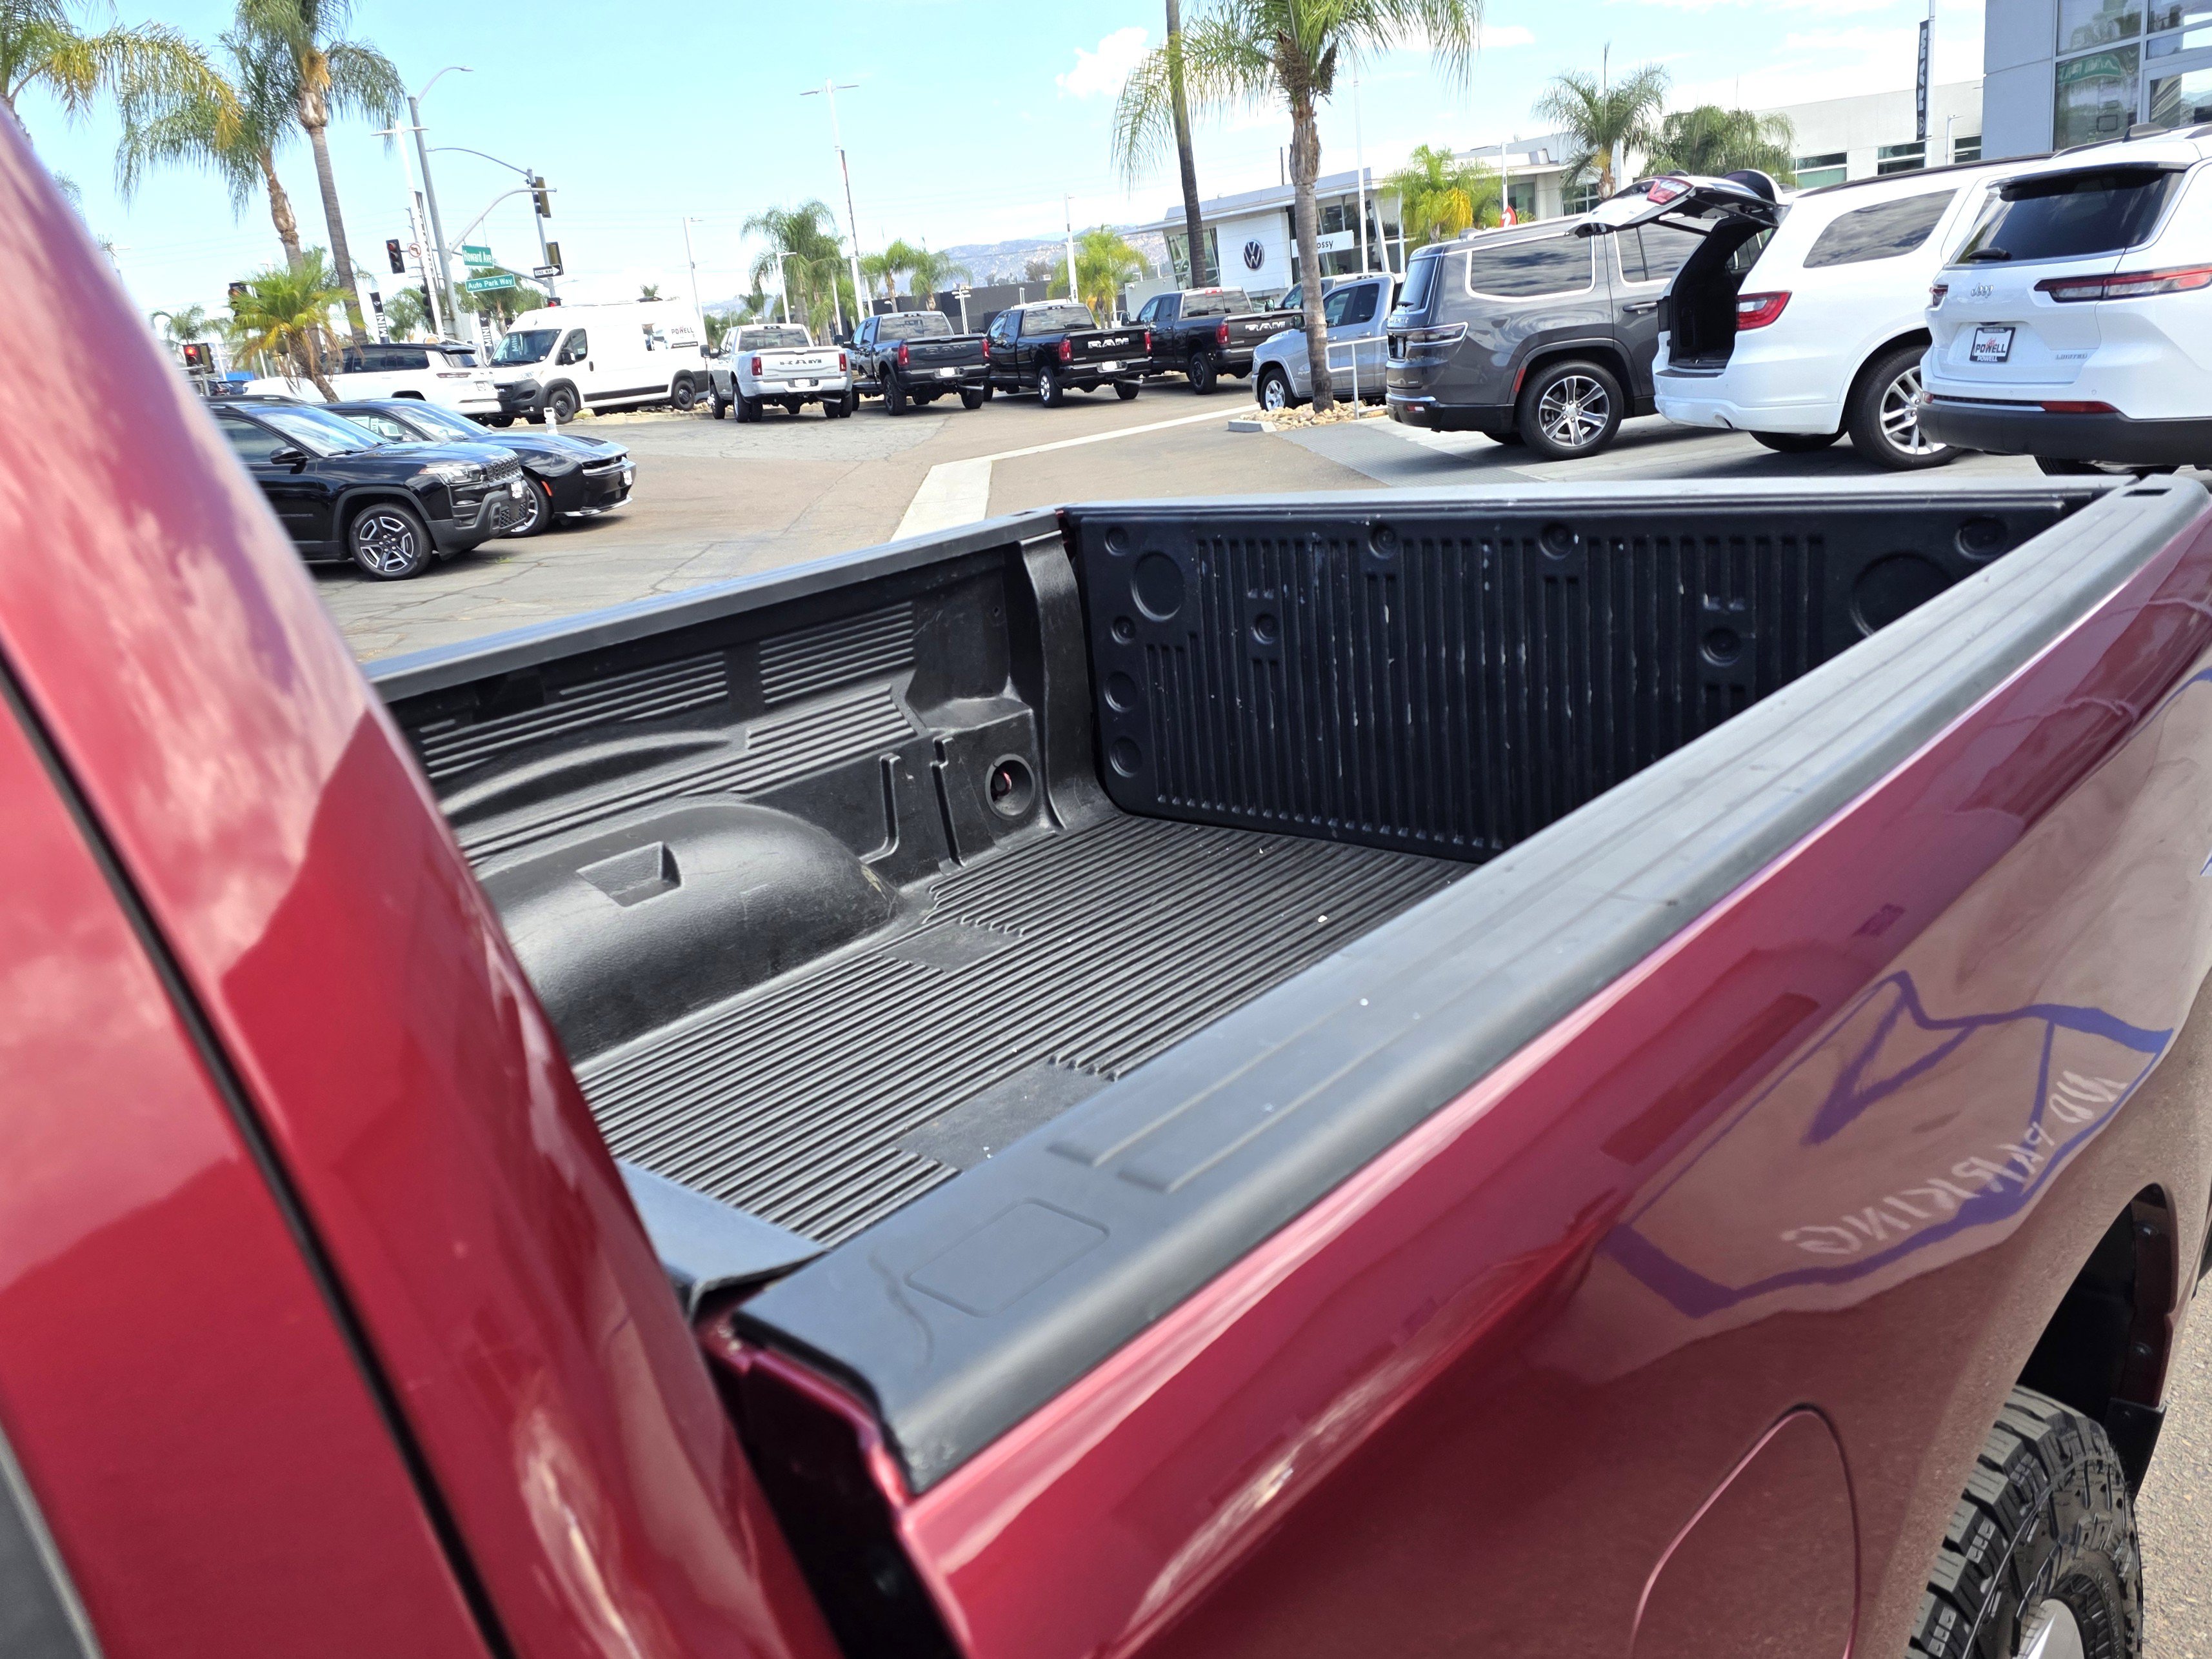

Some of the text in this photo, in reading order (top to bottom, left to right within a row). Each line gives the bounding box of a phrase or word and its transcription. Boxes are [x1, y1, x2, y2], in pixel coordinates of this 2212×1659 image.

[463, 250, 492, 263] Howard Ave
[499, 277, 513, 286] Way
[1971, 283, 1994, 299] Jeep
[376, 312, 388, 337] MINI
[1245, 321, 1286, 332] RAM
[482, 327, 493, 347] MINI
[671, 327, 694, 335] POWELL
[1088, 337, 1129, 349] RAM
[1975, 343, 2006, 354] POWELL
